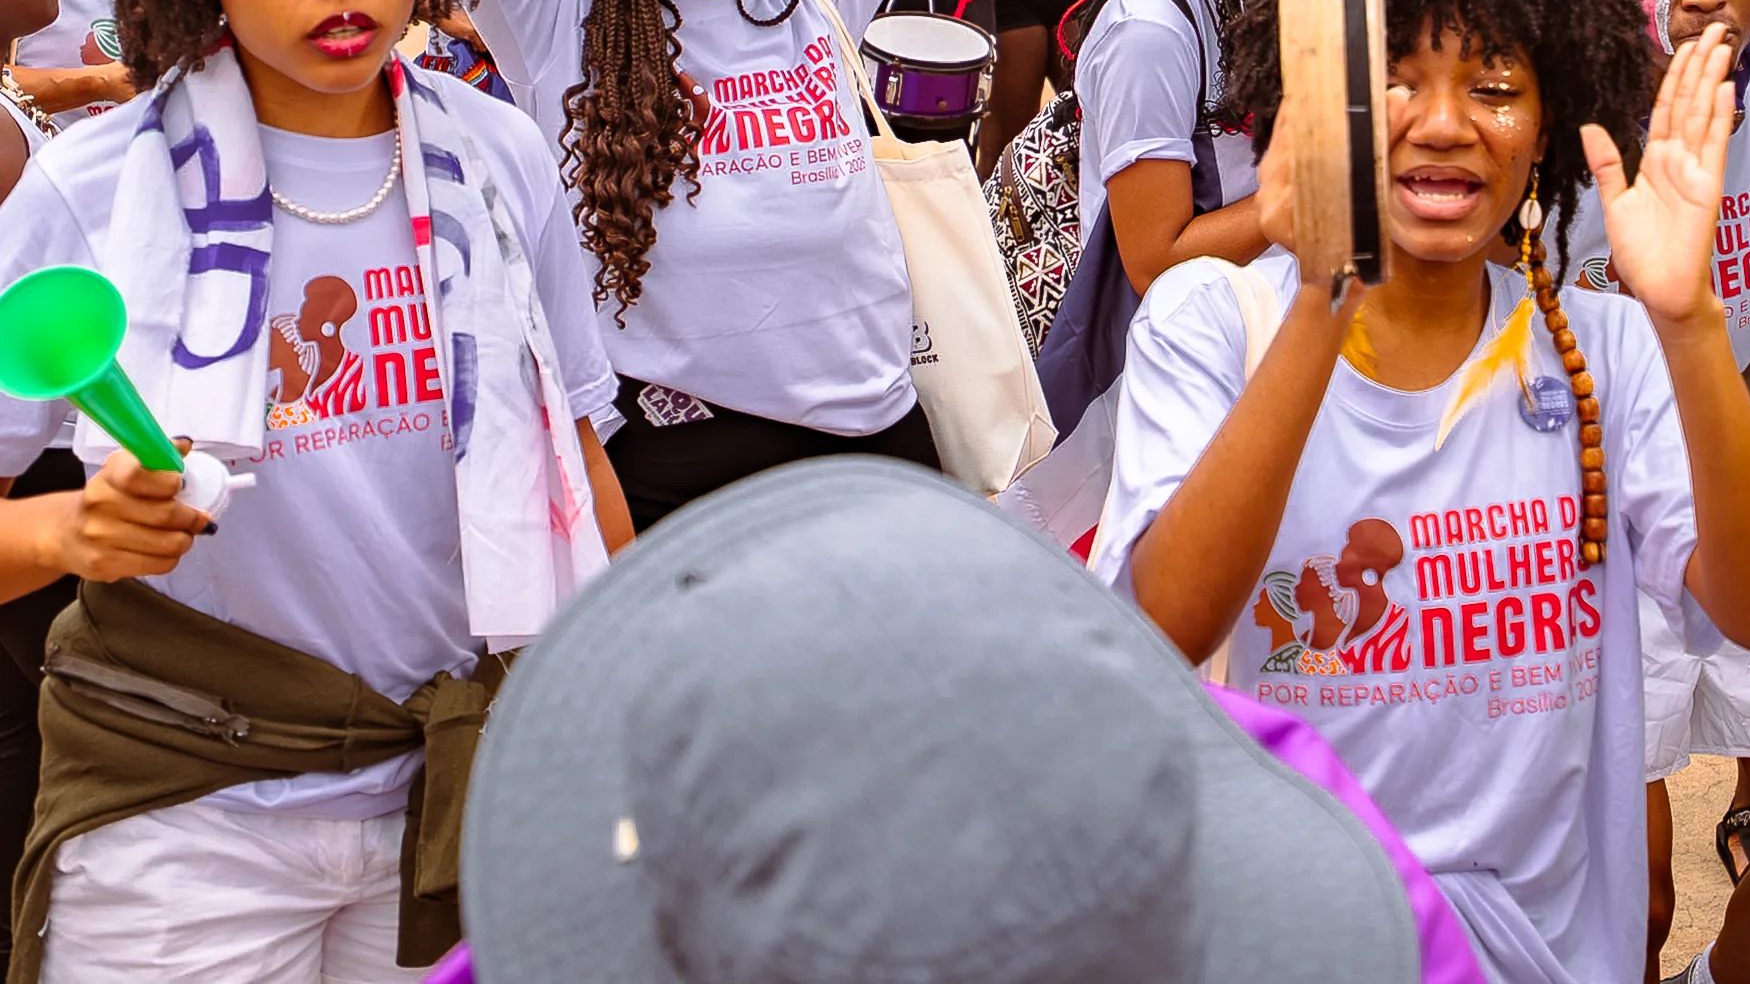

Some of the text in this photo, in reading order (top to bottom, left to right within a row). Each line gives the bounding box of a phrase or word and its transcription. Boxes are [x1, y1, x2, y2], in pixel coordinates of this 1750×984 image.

[713, 63, 810, 104] MARCHA
[789, 152, 802, 167] E
[294, 412, 432, 456] REPARAÇÃO
[1408, 498, 1551, 550] MARCHA
[1257, 683, 1309, 707] POR
[1319, 674, 1480, 708] REPARAÇÃO
[1488, 670, 1503, 693] E
[1511, 665, 1563, 689] BEM
